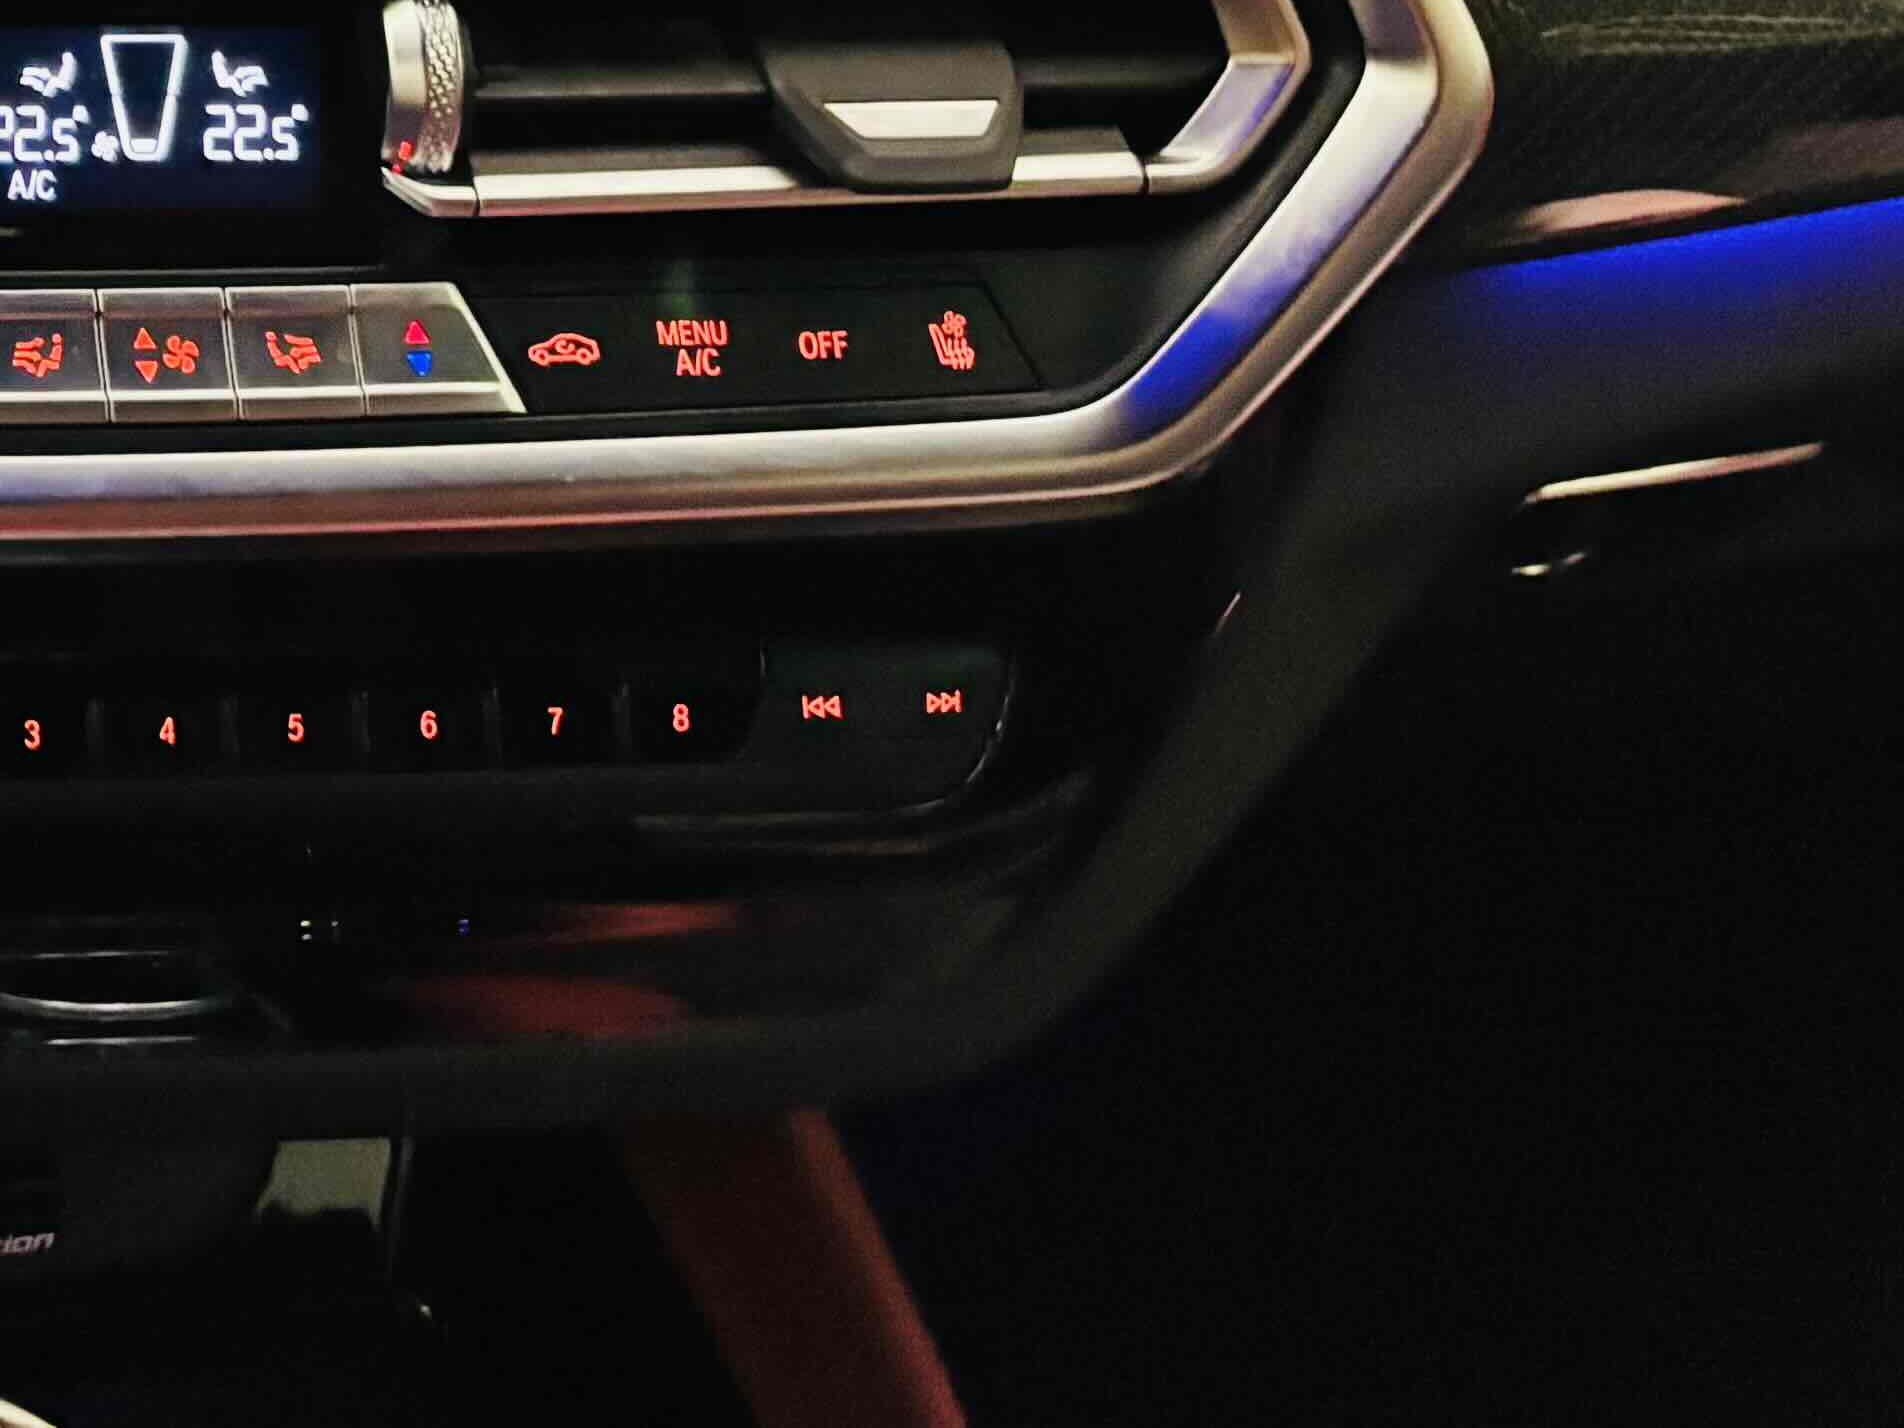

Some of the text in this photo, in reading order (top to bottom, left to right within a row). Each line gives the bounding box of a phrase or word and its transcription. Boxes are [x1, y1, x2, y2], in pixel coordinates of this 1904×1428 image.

[7, 170, 57, 201] A/C
[656, 320, 728, 347] MENU
[798, 331, 847, 359] OFF
[676, 348, 721, 377] A/C
[159, 716, 176, 745] 4
[287, 713, 305, 742] 5
[419, 711, 438, 740] 6
[547, 707, 564, 736] 7
[672, 704, 690, 732] 8
[23, 719, 41, 749] 3
